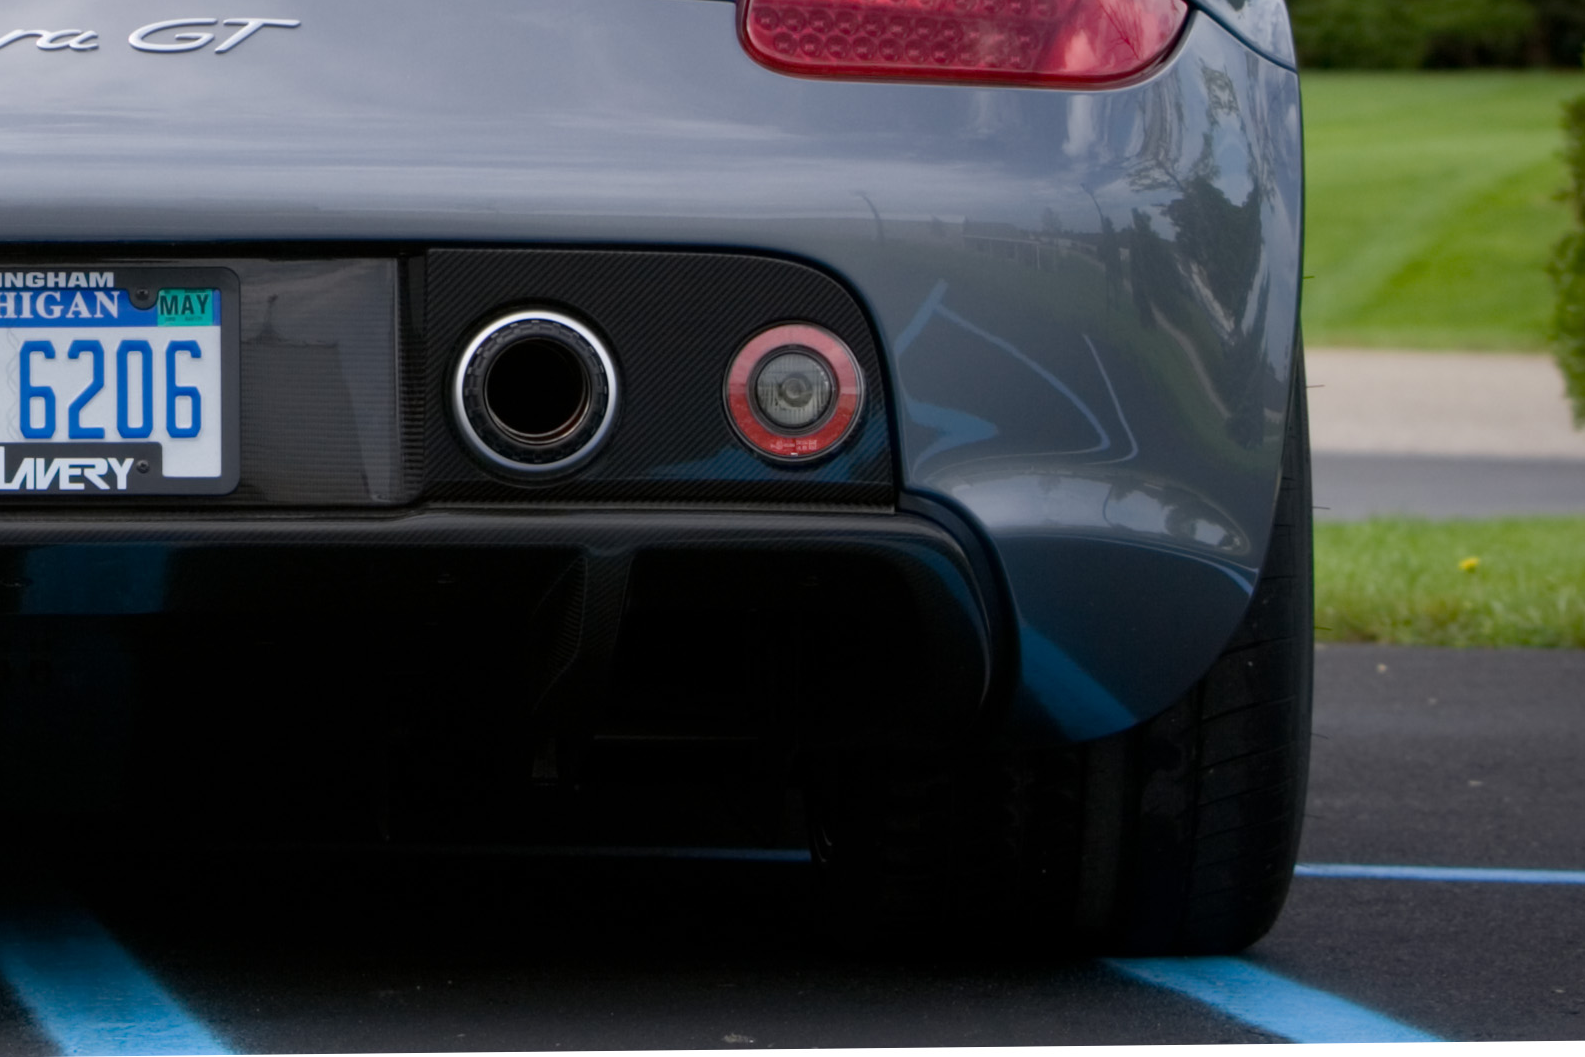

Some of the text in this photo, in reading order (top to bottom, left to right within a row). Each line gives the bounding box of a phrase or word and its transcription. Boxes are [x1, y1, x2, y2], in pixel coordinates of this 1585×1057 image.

[128, 18, 302, 54] GT
[160, 294, 209, 315] MAY
[19, 340, 202, 439] 6206
